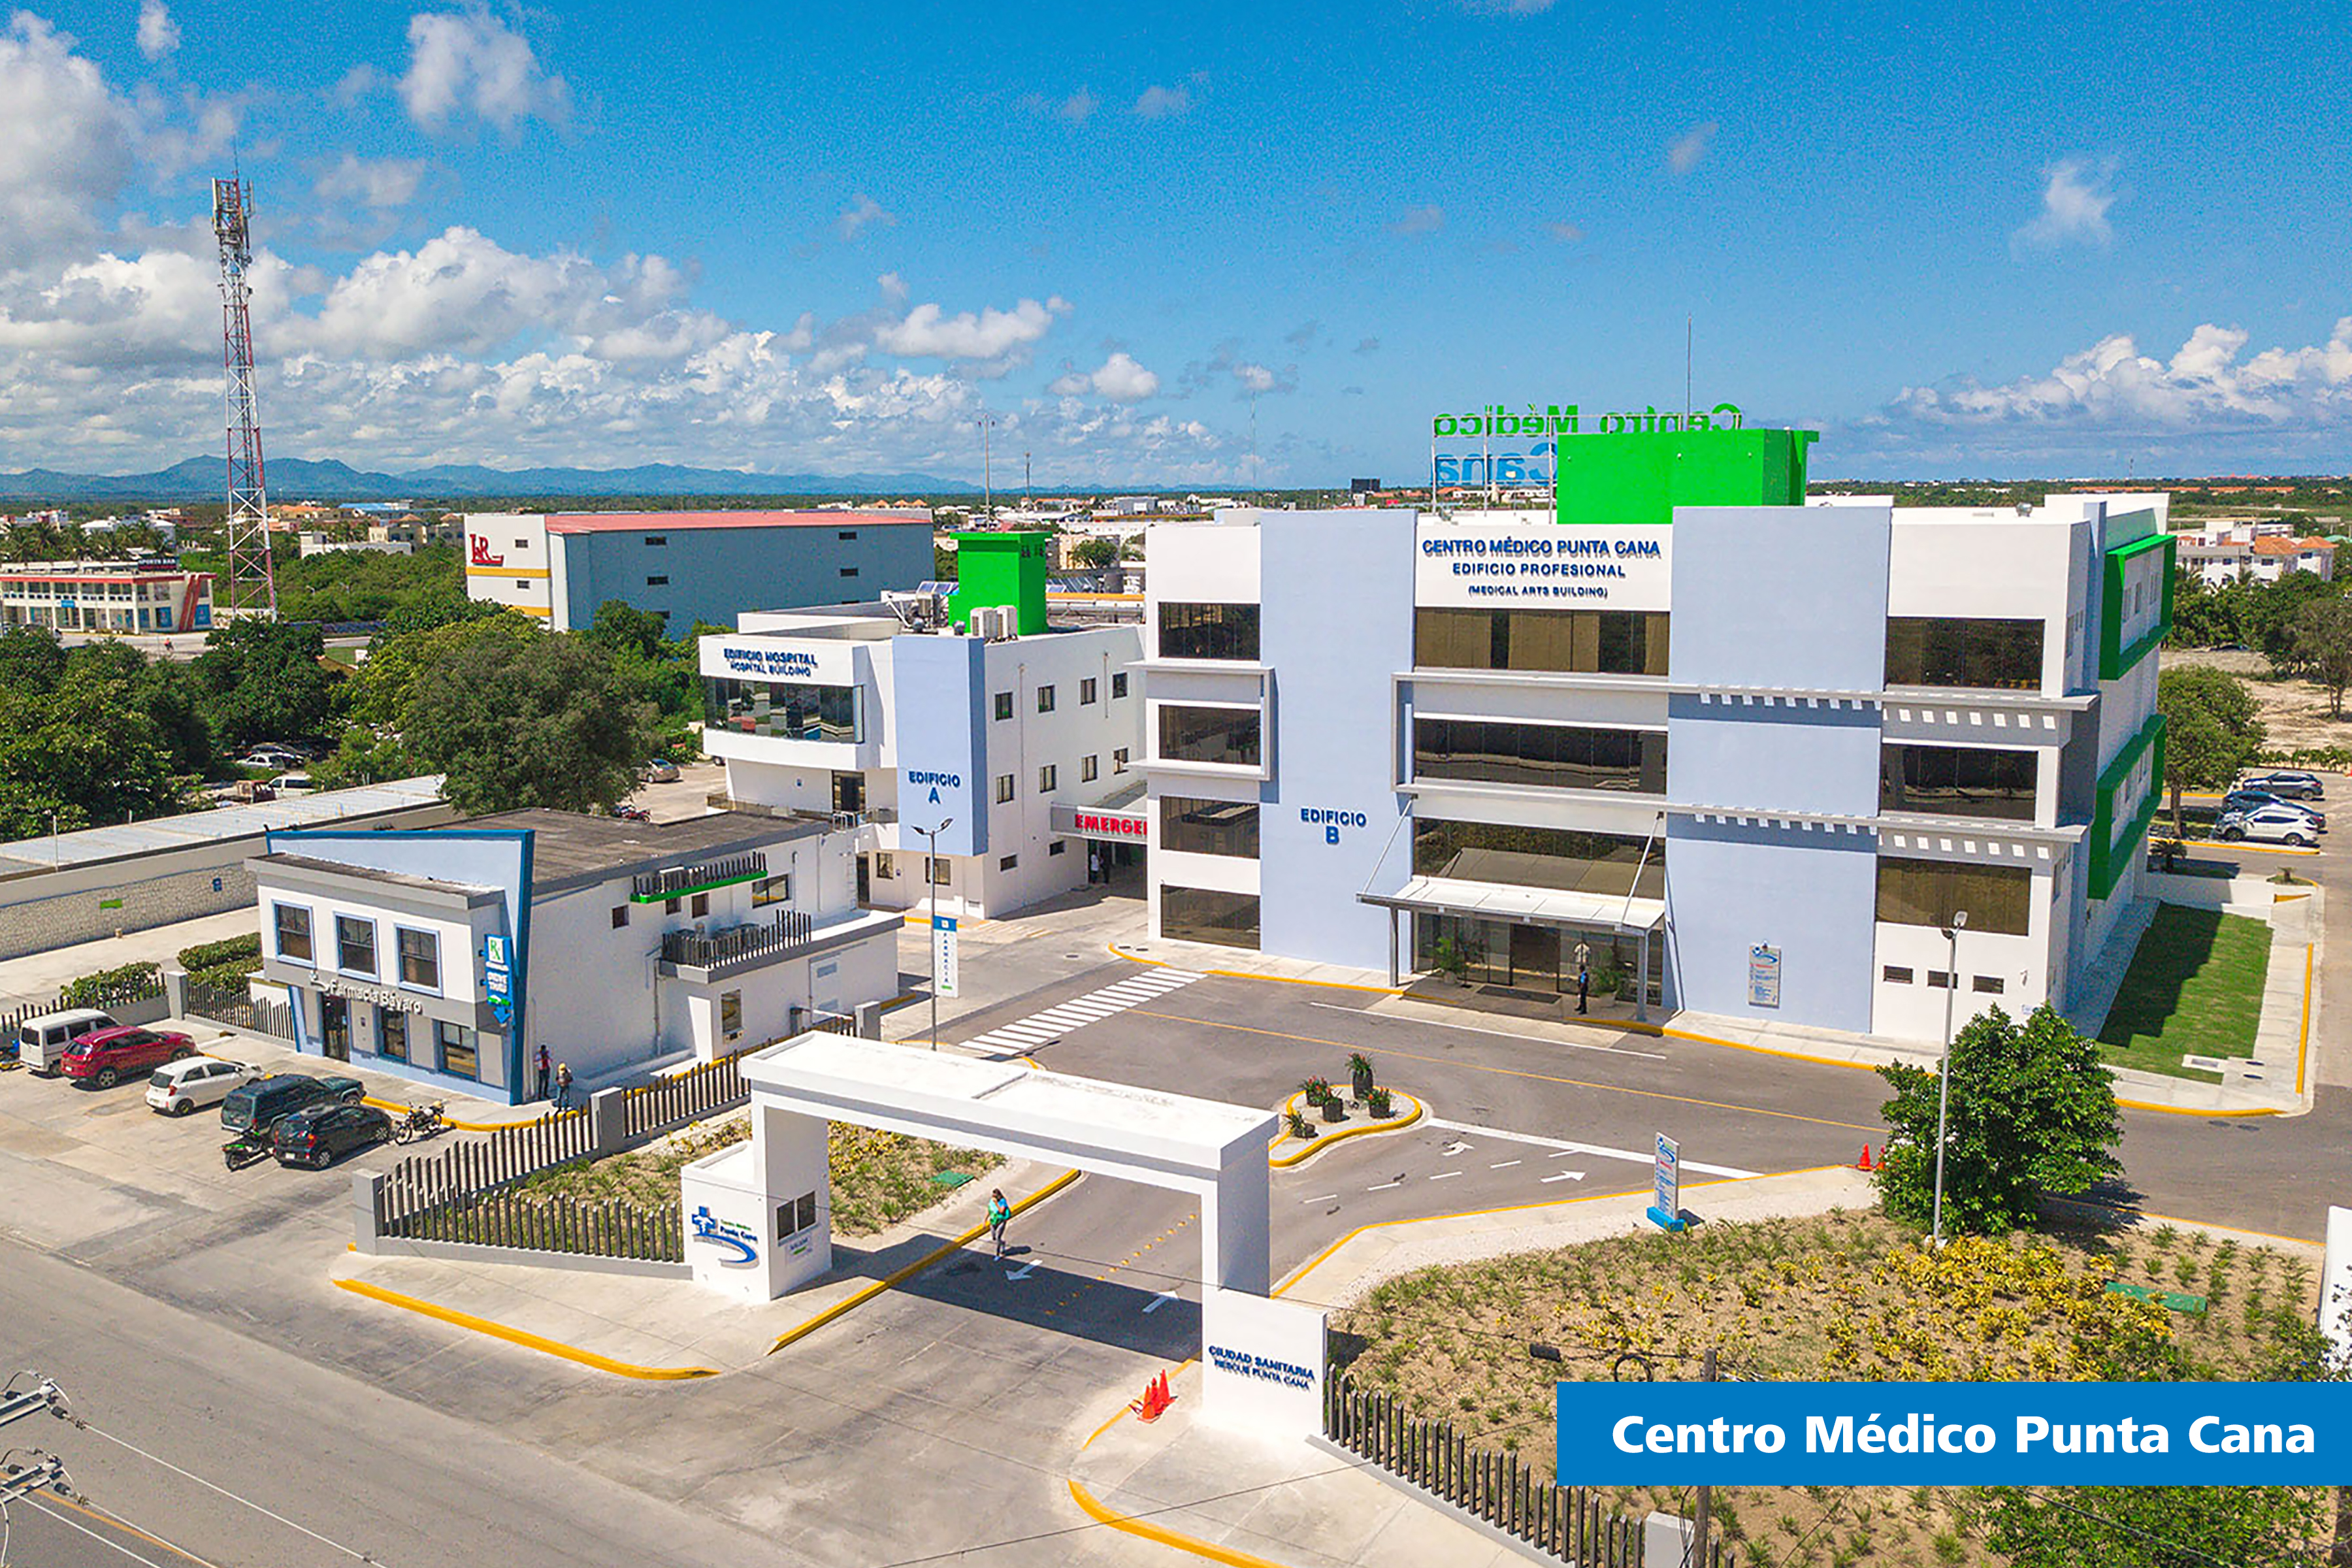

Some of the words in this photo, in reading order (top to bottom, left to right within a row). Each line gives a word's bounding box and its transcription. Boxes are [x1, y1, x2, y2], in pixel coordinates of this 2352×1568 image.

[1422, 540, 1486, 555] CENTRO
[1489, 536, 1553, 555] MÉDICO
[1557, 540, 1610, 555] PUNTA
[1614, 540, 1661, 557] CANA
[1453, 563, 1516, 576] EDIFICIO
[1520, 563, 1625, 578] PROFESIONAL
[1468, 585, 1518, 596] (MEDICAL
[1522, 587, 1550, 597] ARTS
[1553, 587, 1609, 599] BUILDING)
[724, 648, 763, 662] EDIFICIO
[765, 651, 818, 667] HOSPITAL
[730, 661, 767, 674] HOSPITAL
[907, 771, 960, 788] EDIFICIO
[928, 787, 941, 804] A
[1301, 808, 1367, 827] EDIFICIO
[1326, 825, 1339, 845] B
[1209, 1346, 1252, 1364] CIUDAD
[1254, 1356, 1315, 1382] SANITARIA
